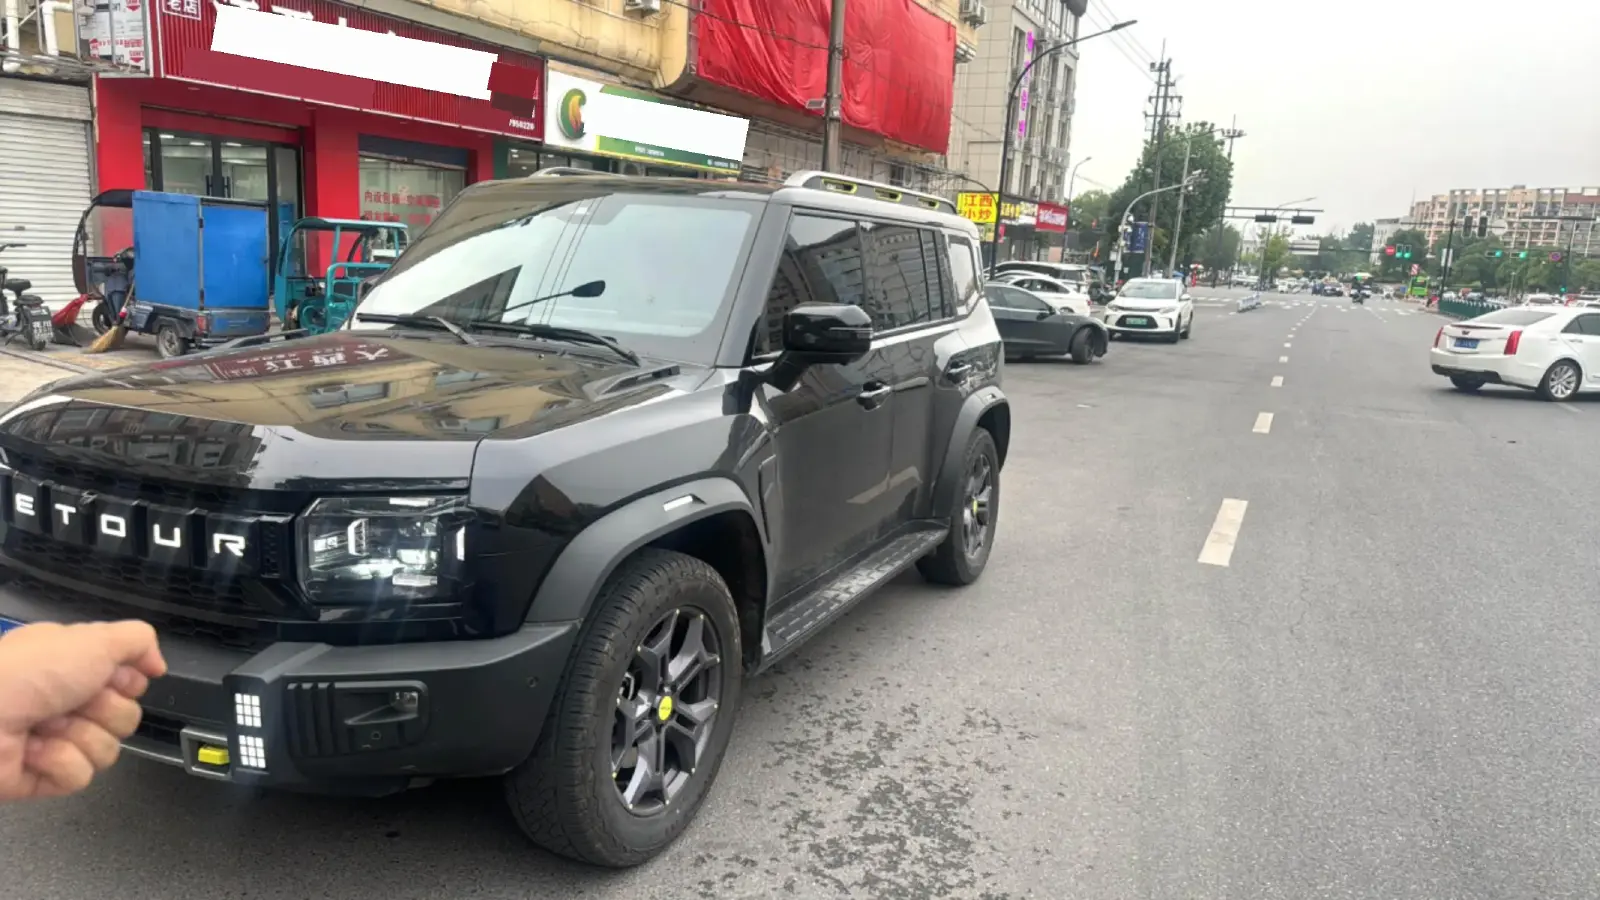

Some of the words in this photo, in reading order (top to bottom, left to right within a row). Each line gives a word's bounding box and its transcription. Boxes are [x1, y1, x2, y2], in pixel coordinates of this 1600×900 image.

[963, 193, 992, 207] 江西
[963, 207, 992, 220] 小炒
[15, 492, 246, 556] ETOUR
